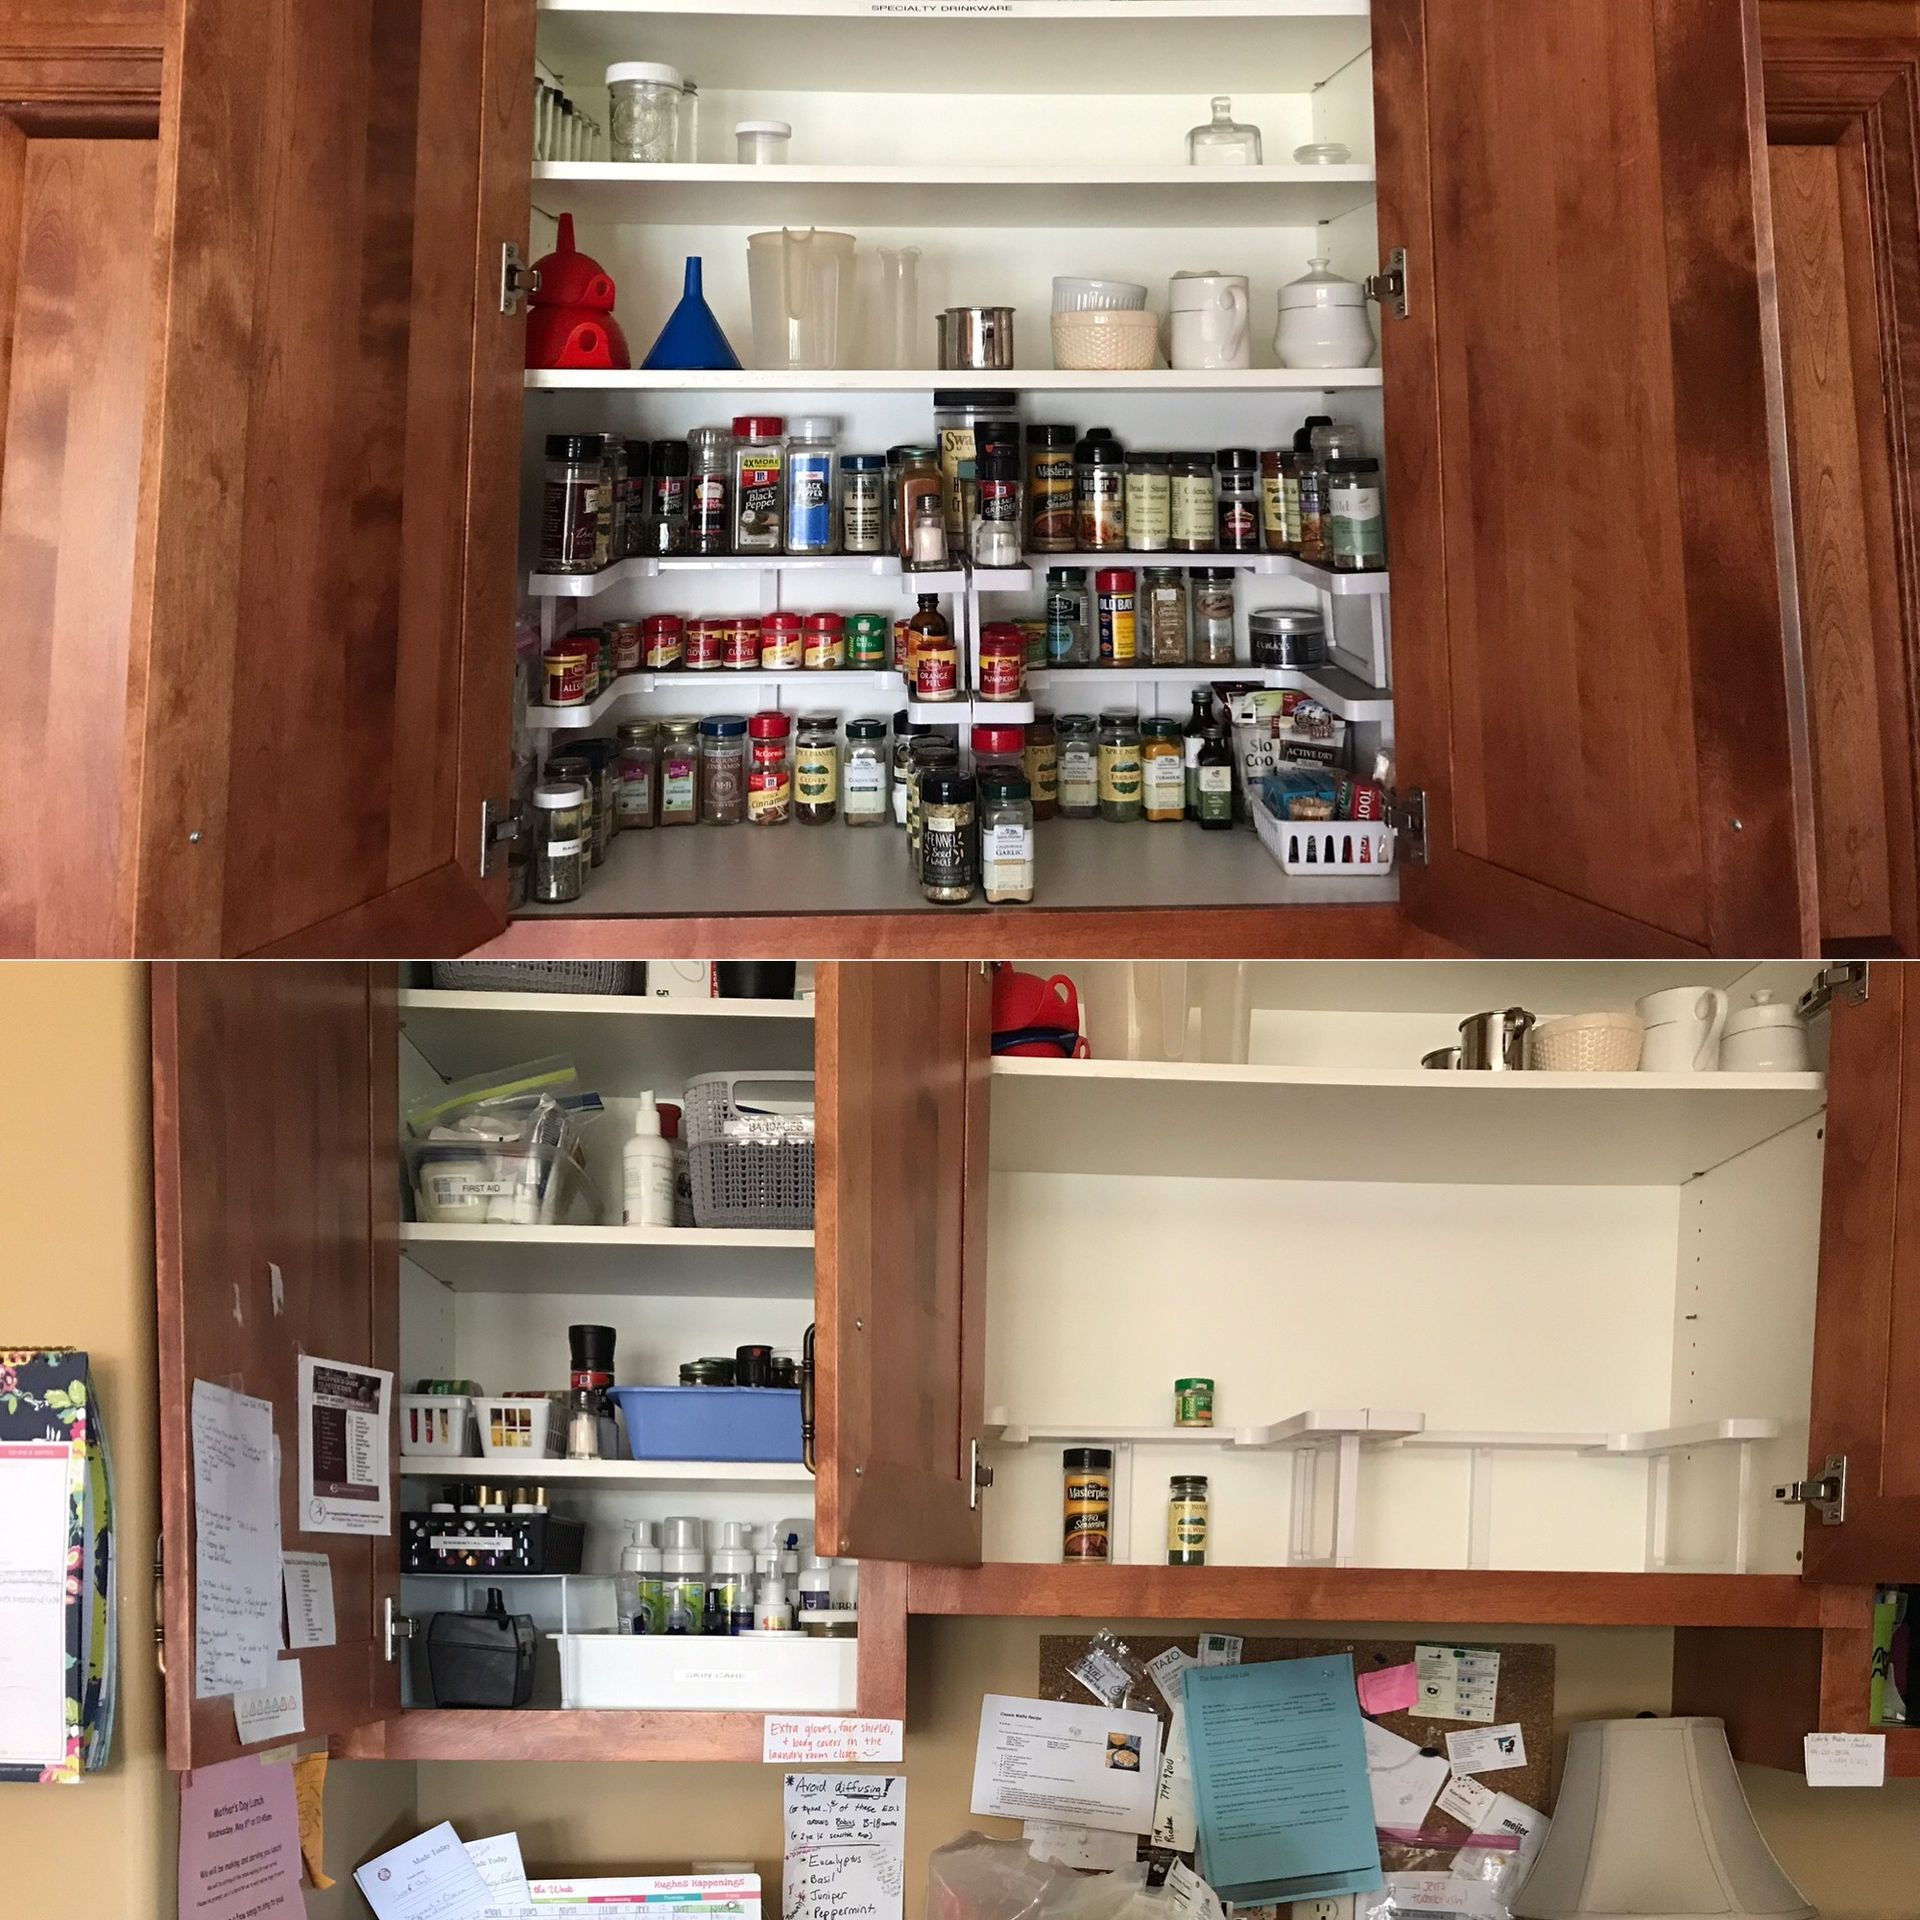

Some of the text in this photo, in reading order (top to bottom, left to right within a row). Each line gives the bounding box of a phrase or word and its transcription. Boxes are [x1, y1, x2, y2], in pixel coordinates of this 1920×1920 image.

[871, 4, 1013, 12] SPECIALTY DRINKWARE
[1082, 478, 1110, 491] weer
[749, 489, 774, 502] Black
[745, 498, 776, 512] Pepper
[1100, 598, 1133, 611] OLD BAY
[687, 648, 711, 657] CLOVES
[728, 648, 754, 656] CLOVES
[920, 672, 948, 680] ORANGE
[984, 674, 1014, 683] PUMPKIN
[925, 679, 942, 687] PEEL
[1287, 747, 1333, 760] ACTIVE DRY
[707, 762, 741, 770] CINNAMON
[751, 792, 789, 809] Cinnamon
[926, 831, 957, 848] FENNEL
[932, 847, 952, 857] Seed
[930, 857, 952, 867] WHOLE
[748, 1122, 804, 1133] BANDAGES
[462, 1184, 501, 1192] FIRST AID
[1152, 1651, 1181, 1671] TAZO
[771, 1722, 799, 1736] Extra
[839, 1720, 858, 1734] face
[860, 1722, 894, 1736] shields,
[792, 1738, 813, 1751] body
[864, 1736, 883, 1746] the
[768, 1748, 803, 1762] laundry
[805, 1750, 829, 1760] room
[795, 1776, 827, 1793] Avoid
[855, 1804, 877, 1813] these
[1502, 1818, 1530, 1836] meijer
[411, 1843, 451, 1866] Made Today
[487, 1856, 508, 1866] Today
[808, 1854, 862, 1874] Eucalyptus
[654, 1878, 745, 1890] Hughes Happenings
[810, 1872, 836, 1885] Basil
[534, 1885, 549, 1894] the
[809, 1889, 848, 1905] Juniper
